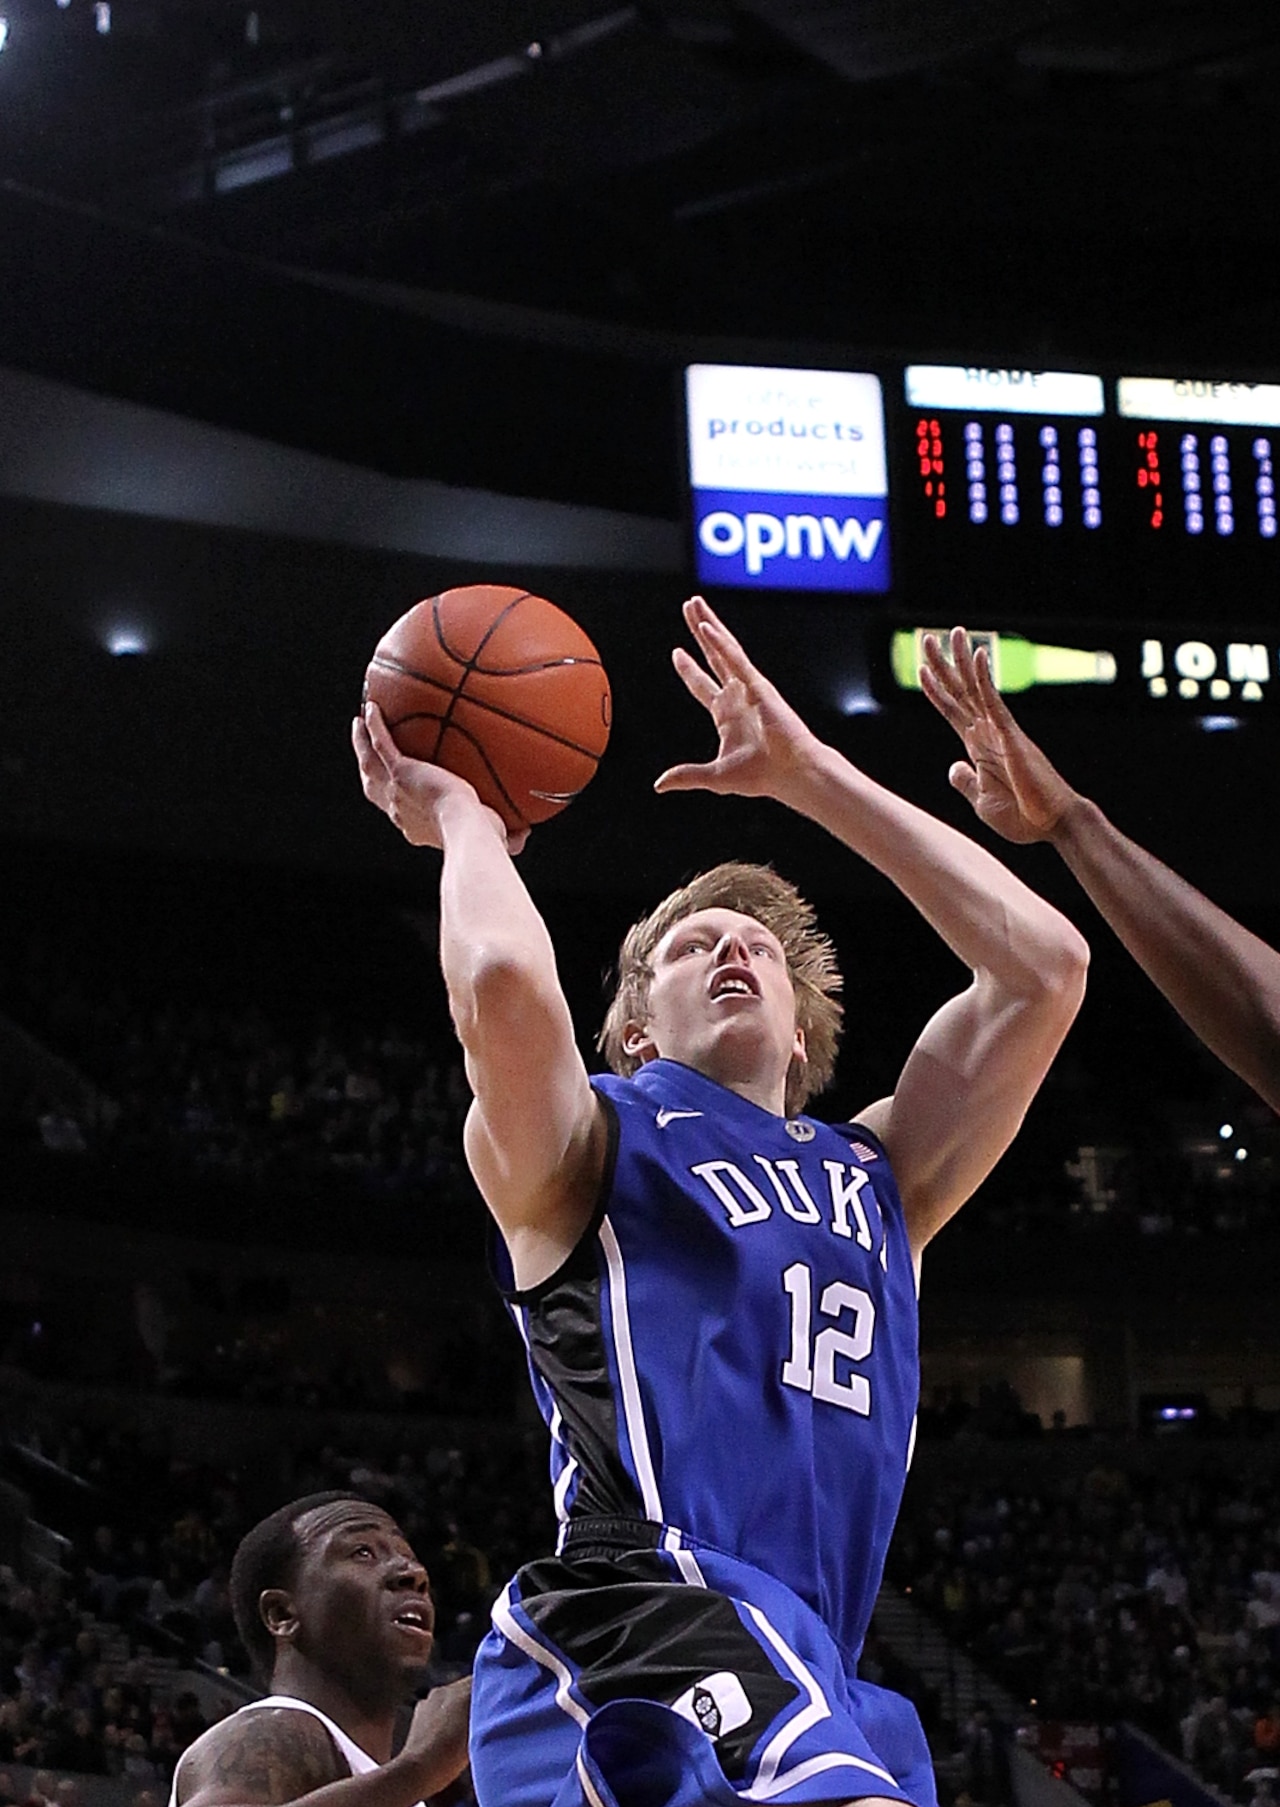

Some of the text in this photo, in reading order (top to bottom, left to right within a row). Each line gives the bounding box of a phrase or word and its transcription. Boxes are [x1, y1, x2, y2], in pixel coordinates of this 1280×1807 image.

[708, 416, 864, 442] products
[699, 511, 883, 576] opnw
[1150, 677, 1263, 701] SODA
[691, 1154, 888, 1273] DUK
[782, 1262, 876, 1417] 12
